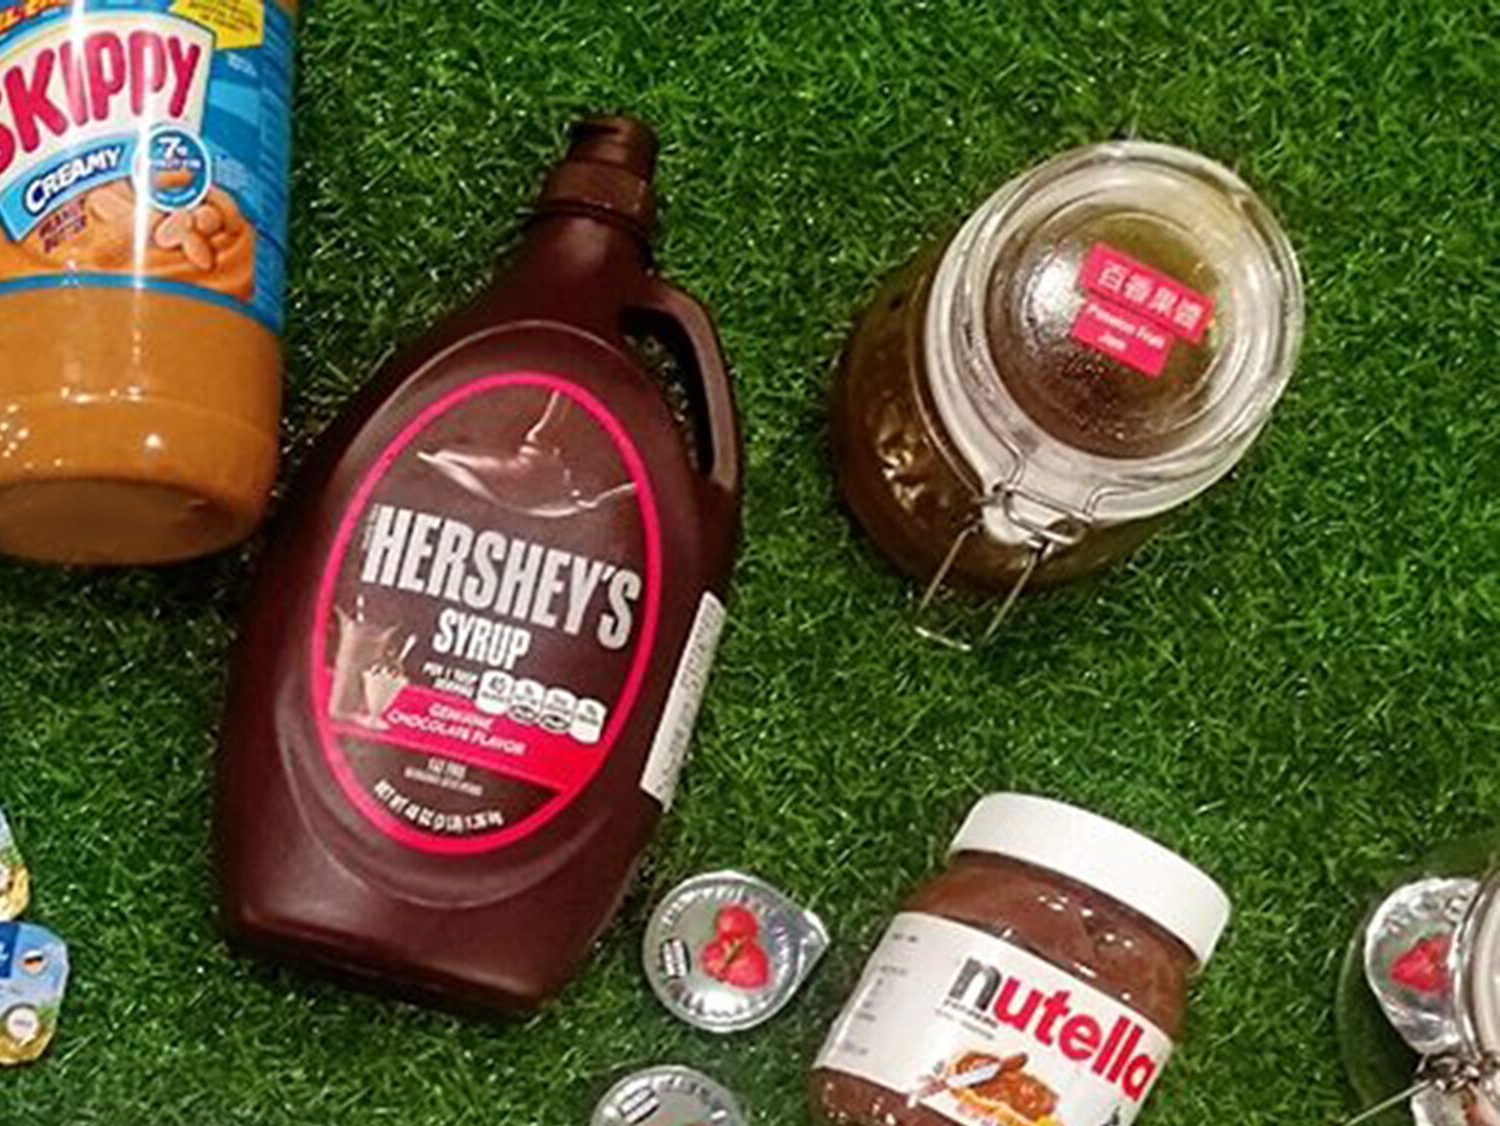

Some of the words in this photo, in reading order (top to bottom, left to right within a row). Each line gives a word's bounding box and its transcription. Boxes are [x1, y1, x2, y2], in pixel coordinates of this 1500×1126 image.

[24, 145, 124, 216] CREAMY
[361, 504, 642, 650] HERSHEY'S
[432, 607, 531, 670] SYRUP
[387, 708, 469, 743] CHOCOLATE
[470, 730, 527, 755] FLAVOR
[948, 956, 1157, 1102] nutella
